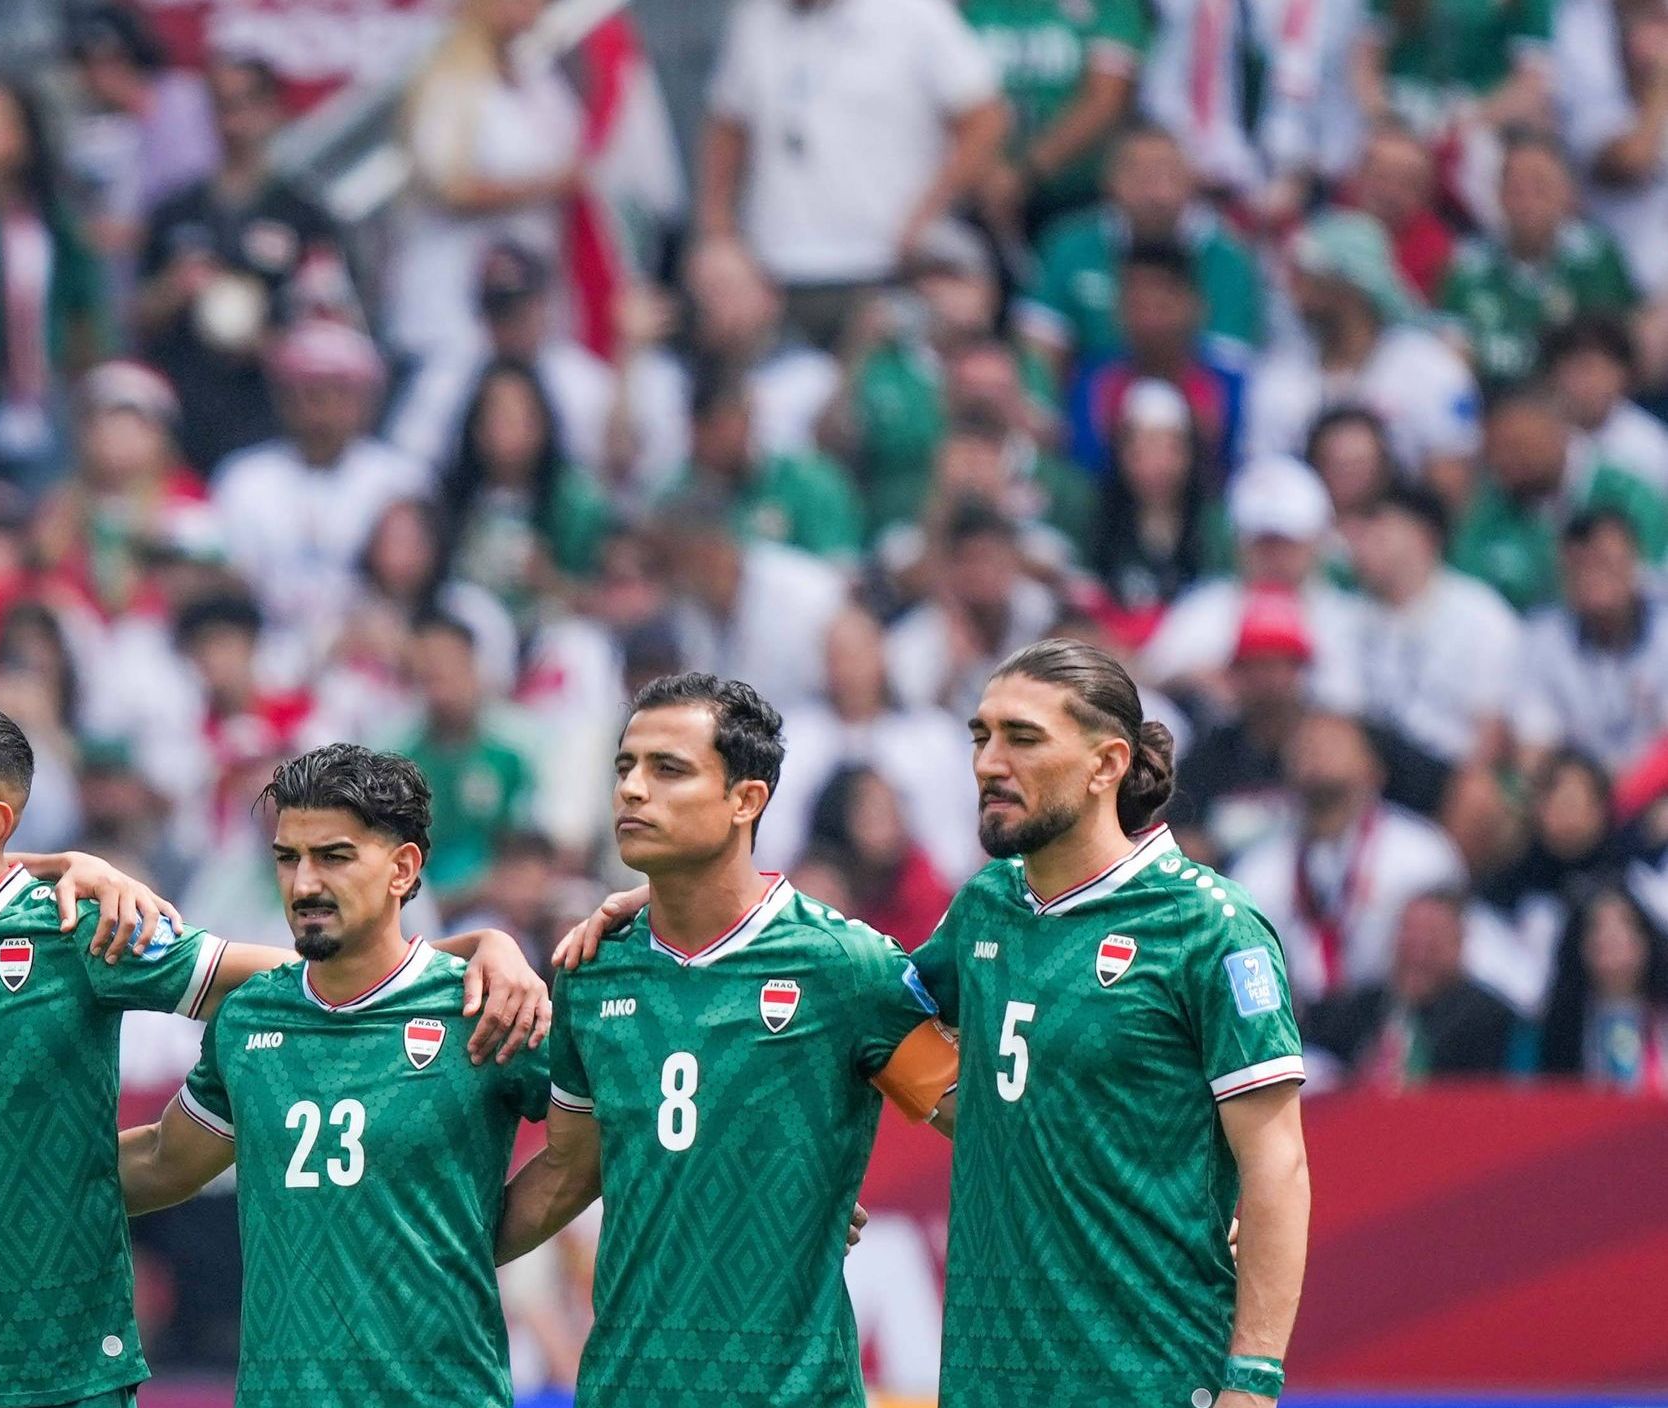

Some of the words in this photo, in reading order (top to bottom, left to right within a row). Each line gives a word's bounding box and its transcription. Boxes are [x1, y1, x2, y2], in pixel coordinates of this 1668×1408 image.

[973, 941, 999, 960] JAKO
[1109, 937, 1131, 946] IRAQ
[600, 998, 637, 1018] JAKO
[414, 1019, 439, 1028] IRAQ
[245, 1031, 283, 1050] JAKO
[996, 1000, 1036, 1102] 5
[657, 1051, 699, 1152] 8
[284, 1098, 366, 1189] 23
